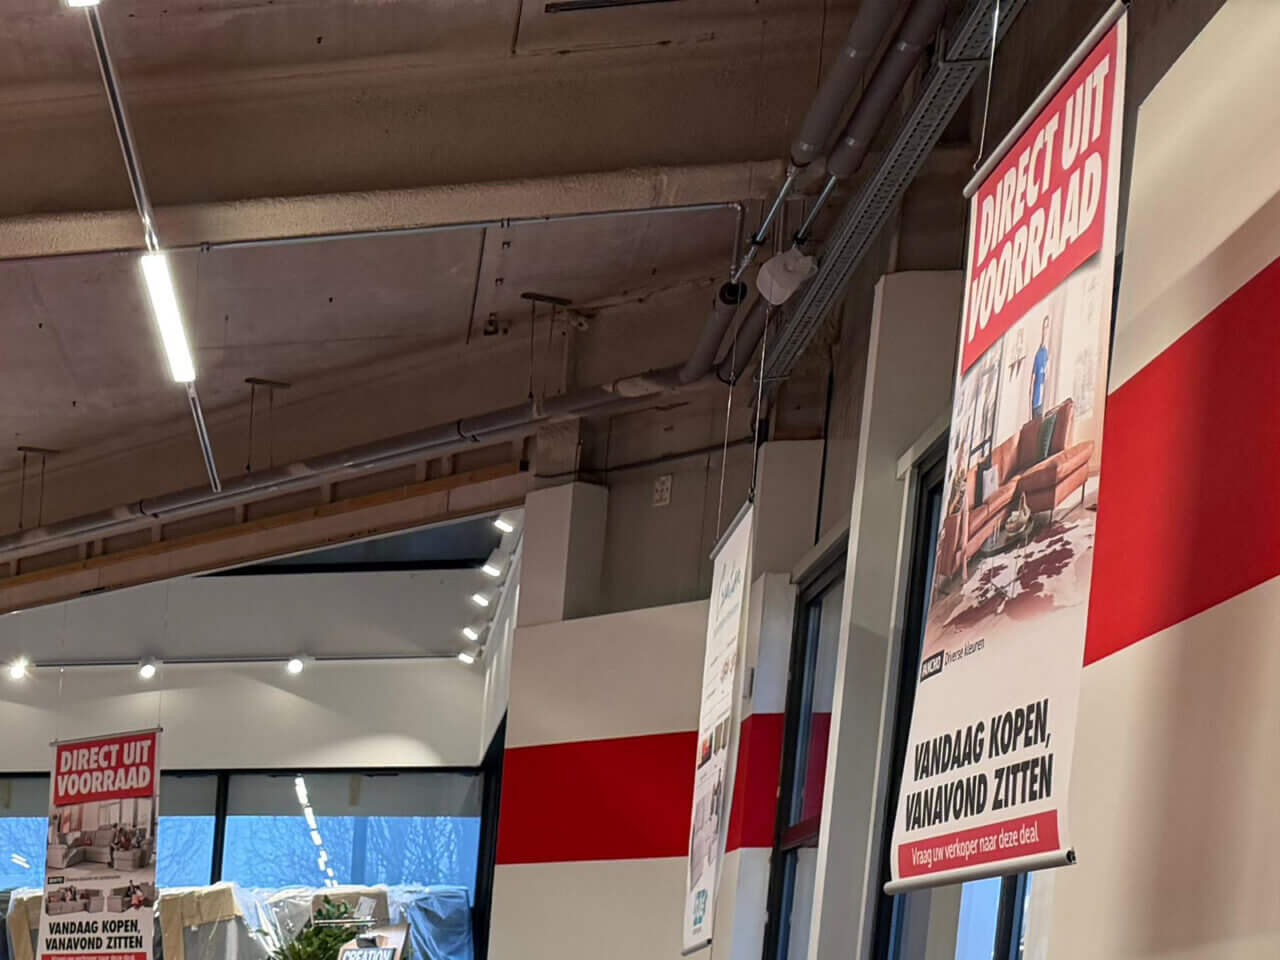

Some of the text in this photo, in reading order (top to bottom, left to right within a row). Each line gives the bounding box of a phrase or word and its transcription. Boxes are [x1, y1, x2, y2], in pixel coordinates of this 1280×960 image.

[977, 54, 1110, 268] DIRECT UIT
[968, 151, 1104, 345] VOORRAAD
[60, 740, 152, 773] DIRECT UIT
[914, 698, 1052, 782] VANDAAG KOPEN,
[57, 766, 151, 797] VOORRAAD
[905, 753, 1054, 832] VANAVOND ZITTEN
[912, 820, 1039, 868] Vraag uw verkoper naar deze deal
[45, 935, 143, 951] VANAVOND ZITTEN
[48, 919, 140, 935] VANDAAG KOPEN,
